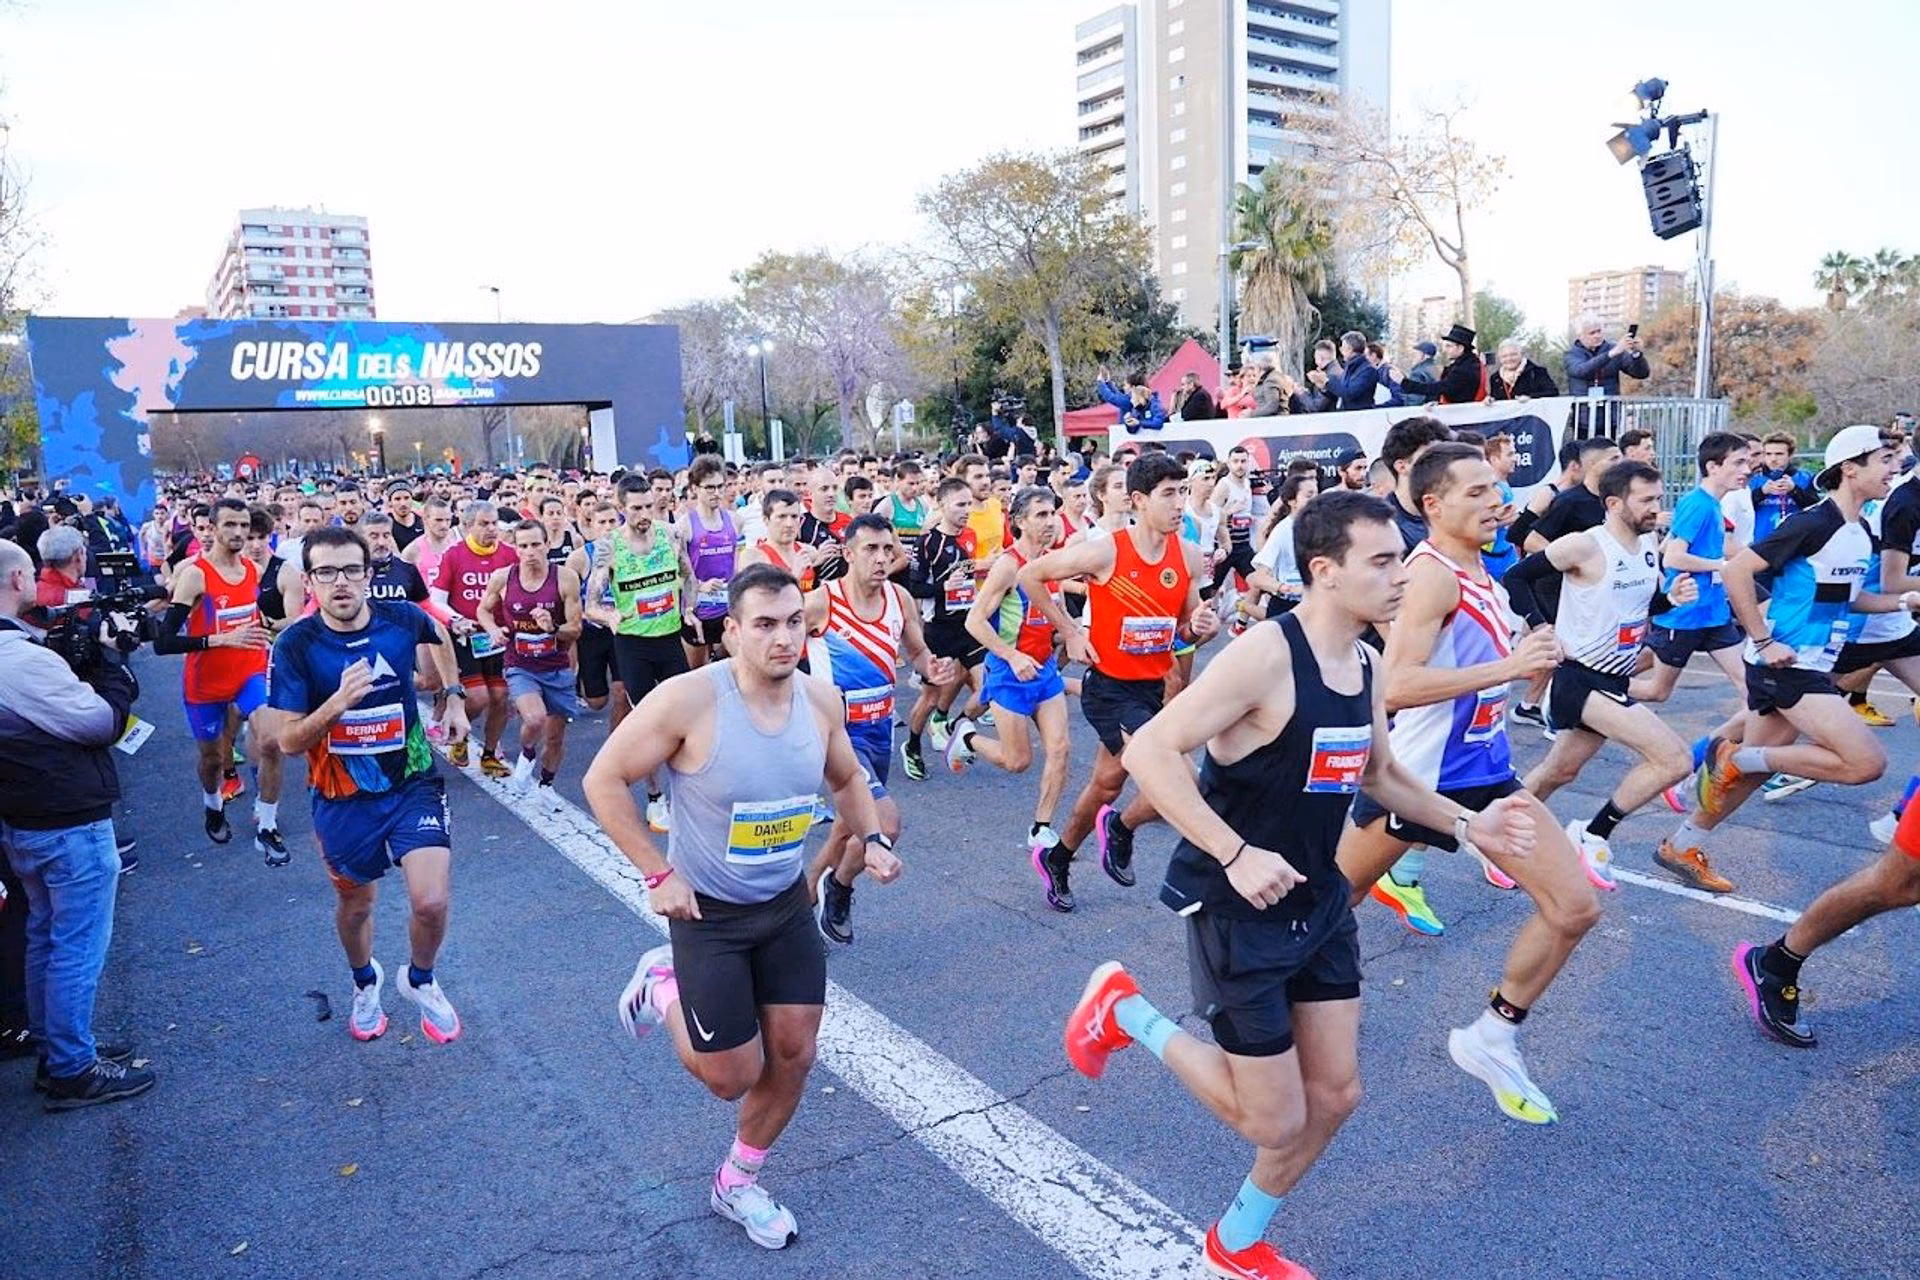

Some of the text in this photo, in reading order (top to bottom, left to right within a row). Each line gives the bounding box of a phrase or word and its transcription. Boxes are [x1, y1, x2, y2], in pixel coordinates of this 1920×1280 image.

[231, 341, 542, 380] CURSA DELS NASSOS
[366, 385, 432, 406] 00:08
[1517, 431, 1533, 445] de
[1333, 446, 1344, 459] d
[345, 723, 389, 736] BERNAT
[754, 820, 794, 837] DANIEL
